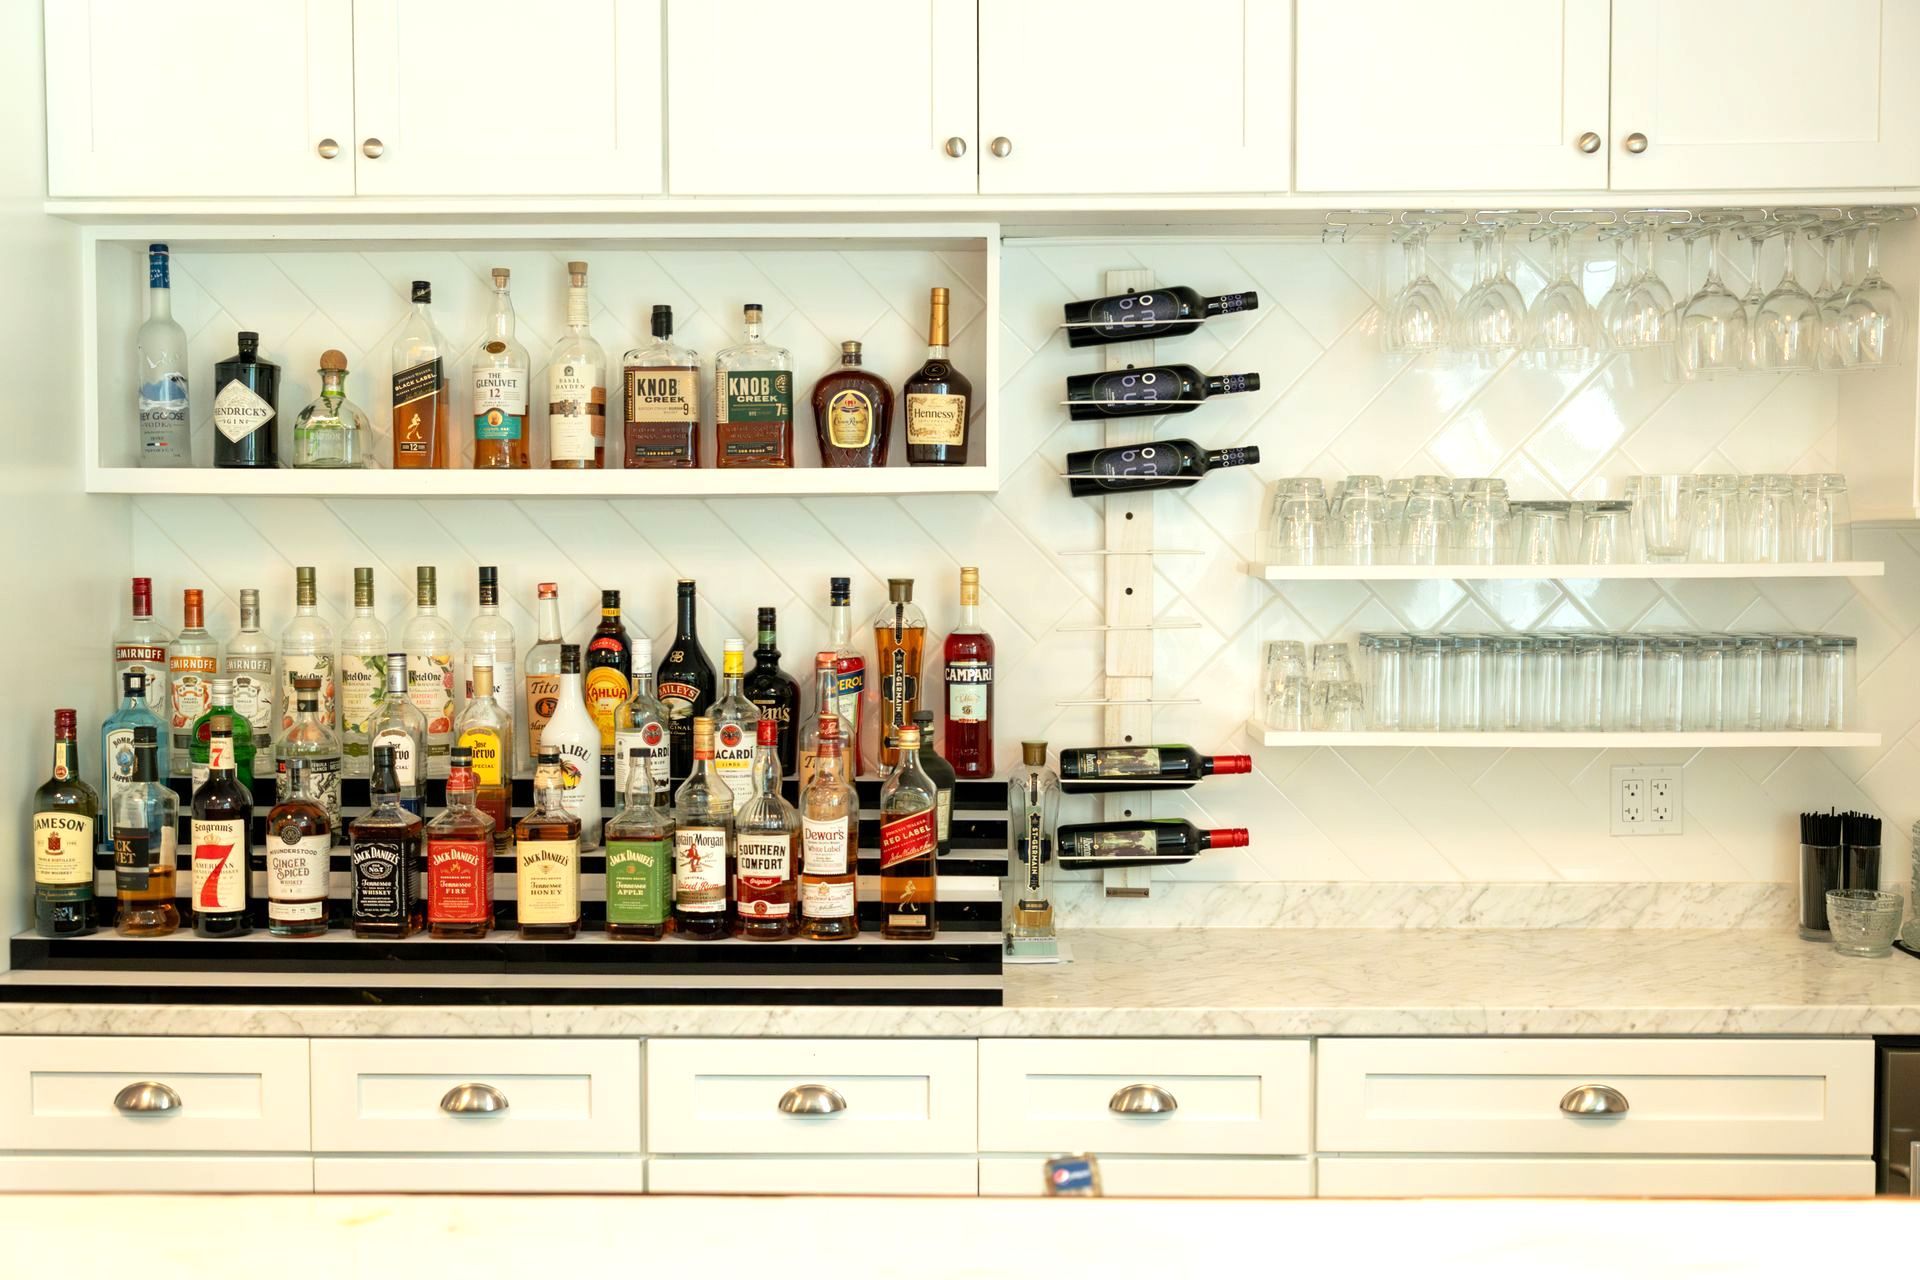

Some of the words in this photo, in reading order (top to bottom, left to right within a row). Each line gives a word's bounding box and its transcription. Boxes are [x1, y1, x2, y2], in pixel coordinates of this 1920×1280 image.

[394, 380, 415, 392] BLACK
[416, 374, 437, 384] LABEL
[476, 380, 518, 388] GLENLIVET
[638, 378, 678, 396] KNOB
[729, 377, 770, 396] KNOB
[490, 390, 501, 398] 12
[683, 403, 688, 415] 9
[776, 403, 782, 416] 7
[914, 409, 954, 419] Hennessy
[117, 648, 162, 659] SMIRNOFF
[357, 672, 372, 680] One
[428, 672, 441, 680] One
[945, 668, 992, 682] CAMPARI
[532, 680, 559, 694] Tito
[474, 740, 486, 749] Jose
[212, 748, 223, 767] 7
[395, 751, 409, 760] rvo
[473, 749, 495, 758] uervo
[560, 744, 591, 761] LIBU
[716, 746, 753, 759] ACARDÍ
[34, 818, 84, 832] JAMESON
[194, 824, 233, 833] Seagram's
[805, 827, 844, 840] Dewar's
[883, 835, 901, 846] RED
[902, 824, 932, 838] LABEL
[694, 833, 724, 848] Morgan
[354, 850, 371, 864] JACK
[371, 847, 400, 865] DANIEL'S
[739, 845, 786, 856] SOUTHERN
[273, 858, 306, 870] GINGER
[433, 852, 451, 866] JACK
[451, 849, 479, 866] DANIEL'S
[523, 853, 541, 867] JACK
[541, 850, 569, 867] DANIEL'S
[610, 852, 626, 866] JACK
[626, 850, 655, 868] DANIEL'S
[742, 858, 783, 869] COMFORT
[194, 843, 235, 907] 7
[277, 868, 310, 880] SPICED
